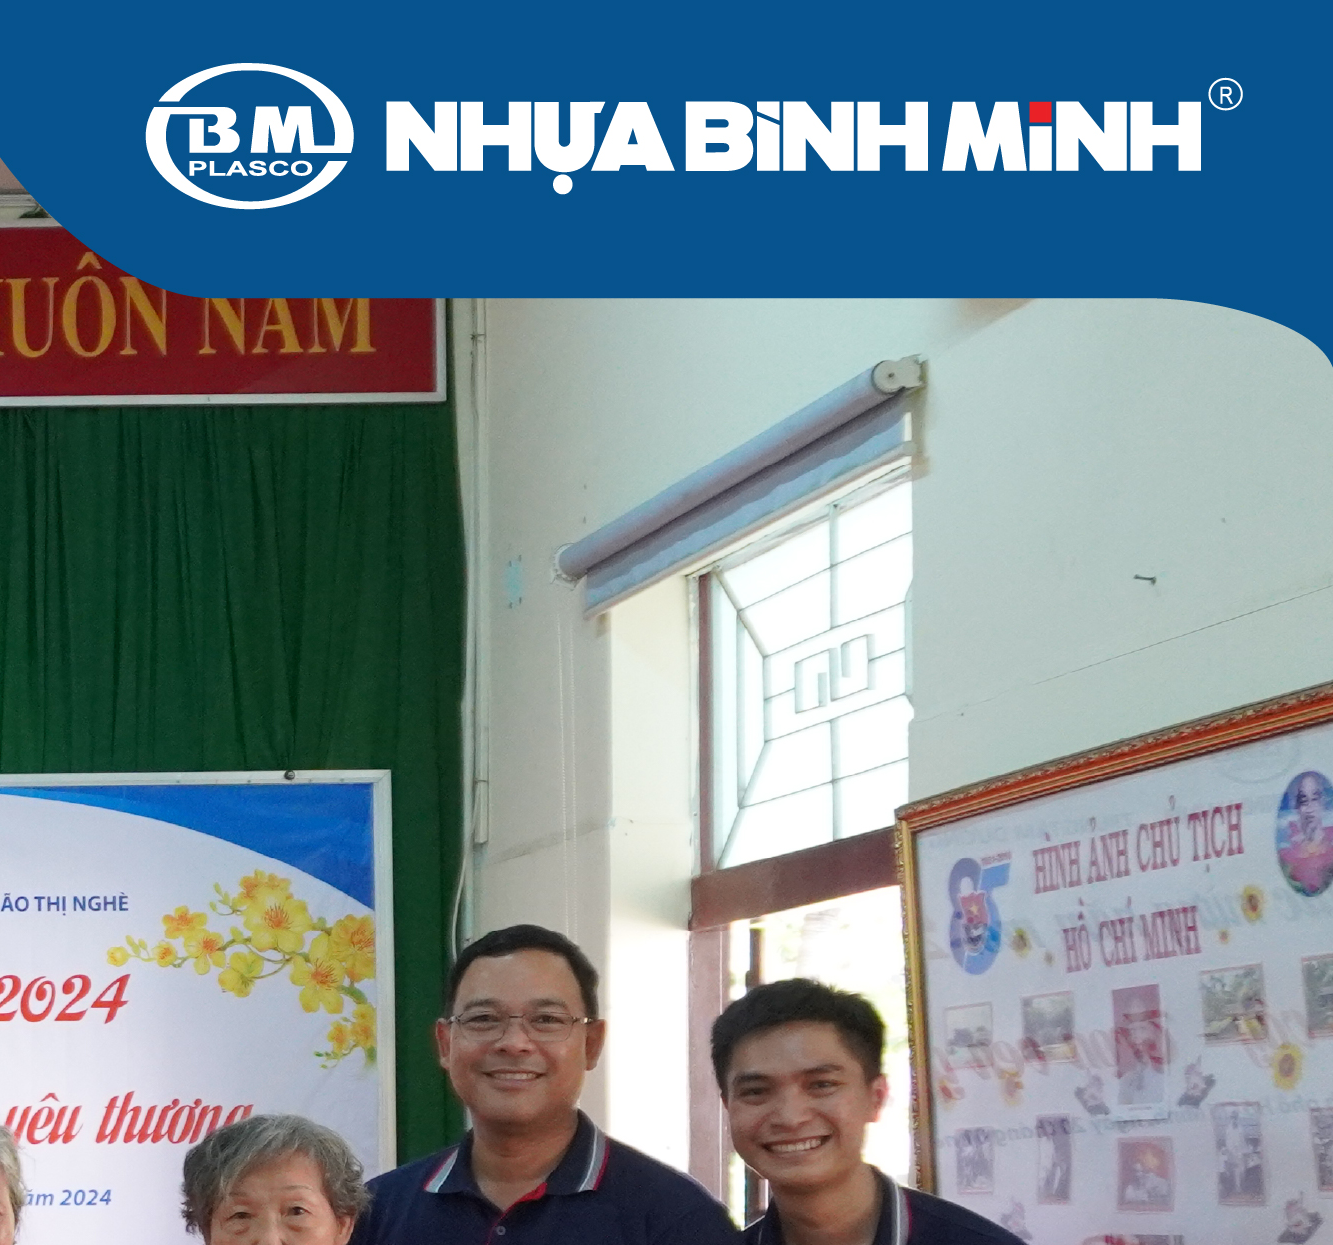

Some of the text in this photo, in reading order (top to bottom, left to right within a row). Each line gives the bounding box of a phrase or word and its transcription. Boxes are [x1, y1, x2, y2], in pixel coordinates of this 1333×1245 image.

[1033, 795, 1244, 894] HÌNH ẢNH CHỦ TỊCH
[34, 895, 67, 916] THỊ
[73, 892, 129, 912] NGHÈ
[1140, 905, 1202, 961] MINH
[25, 1189, 111, 1206] ăm 2024
